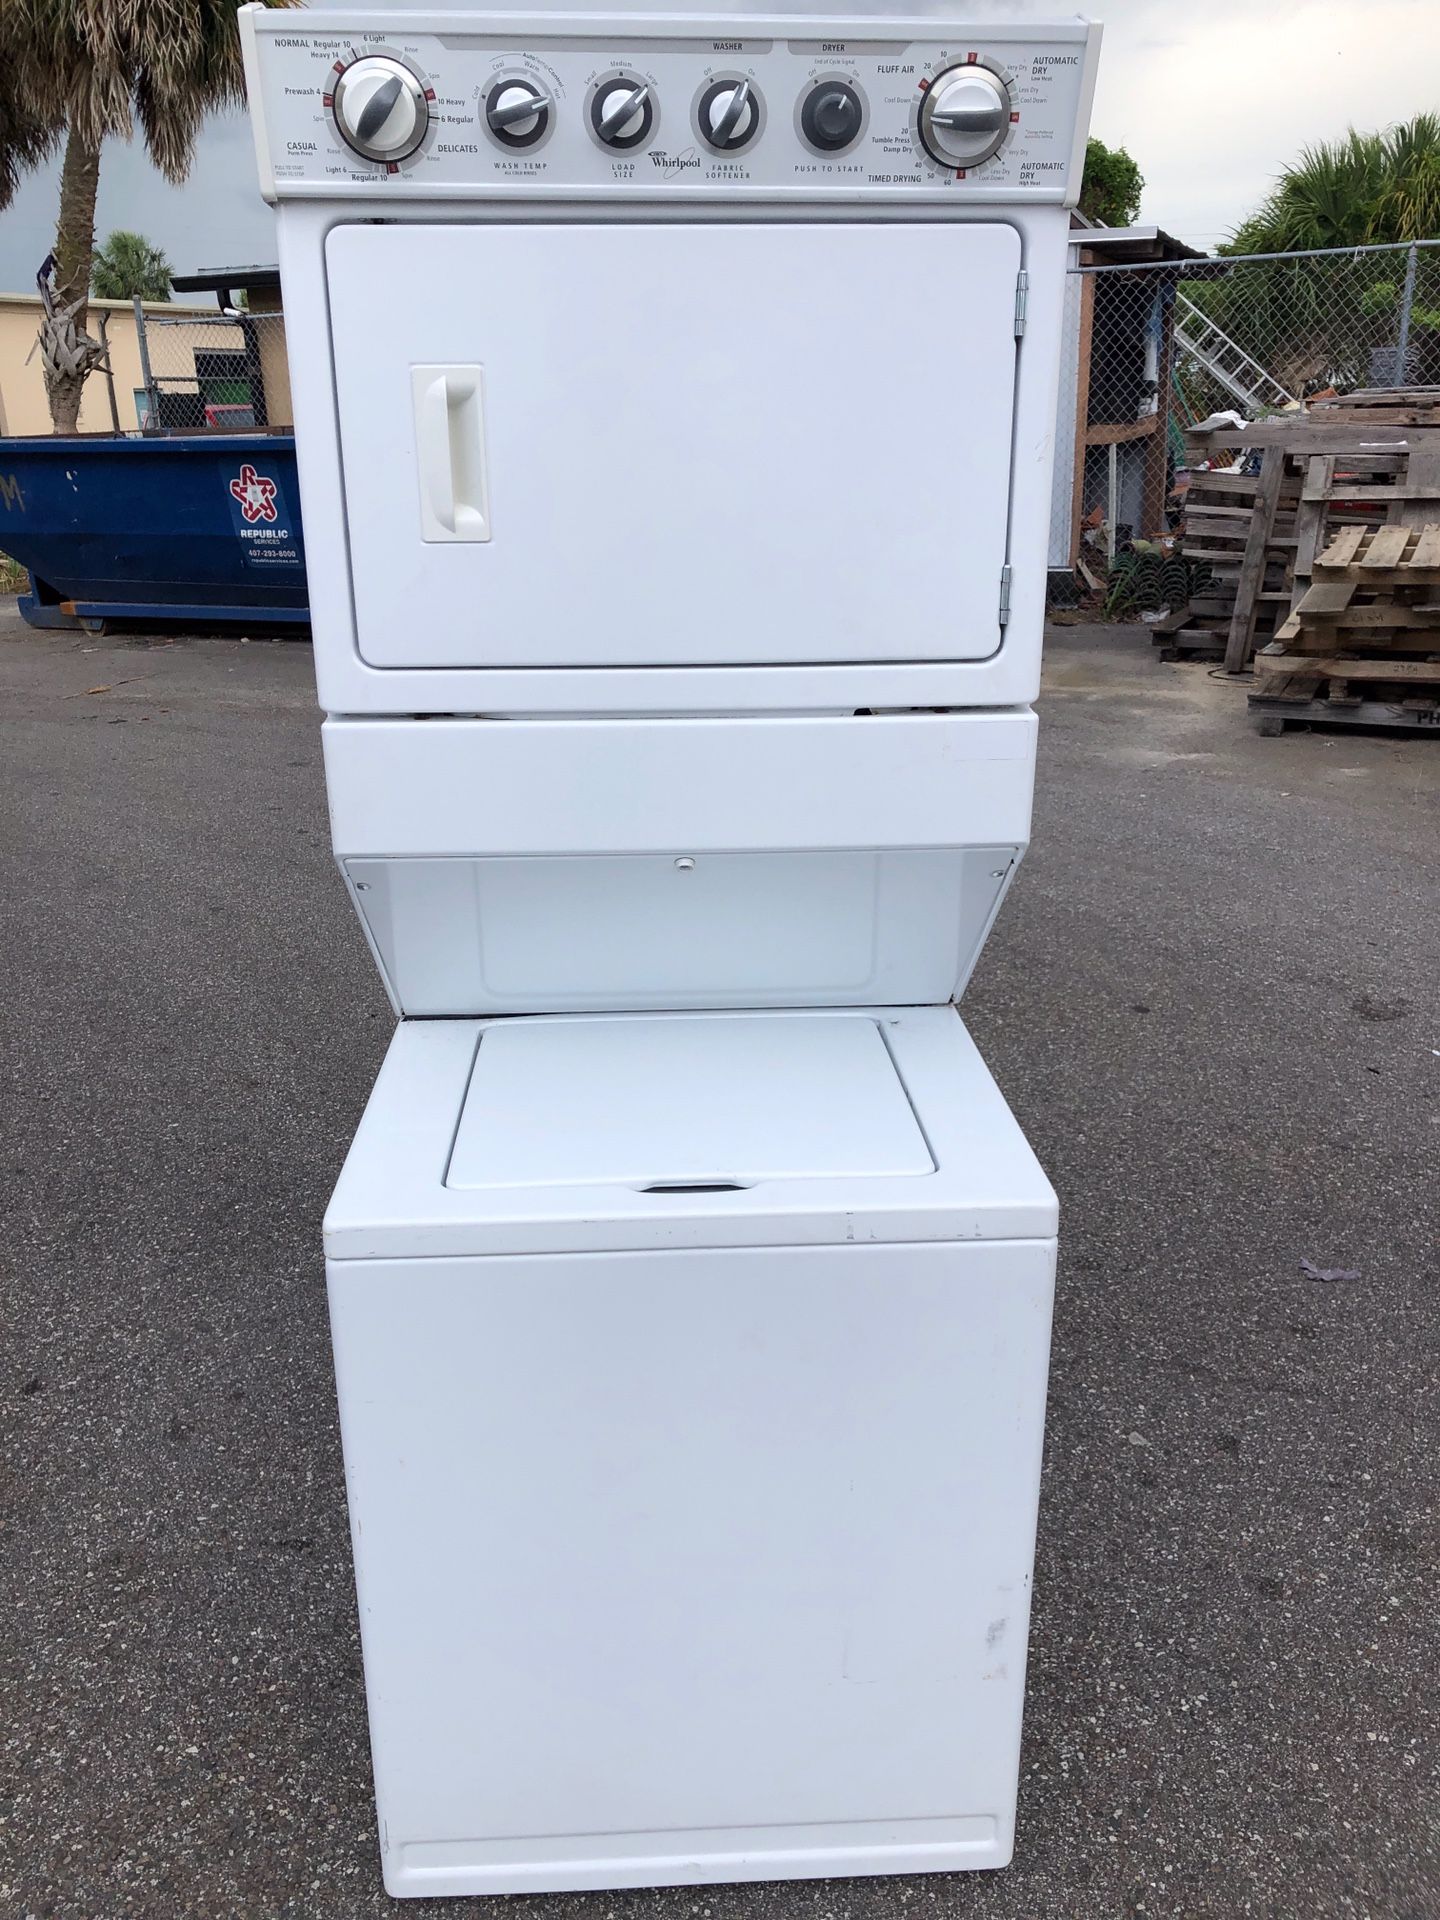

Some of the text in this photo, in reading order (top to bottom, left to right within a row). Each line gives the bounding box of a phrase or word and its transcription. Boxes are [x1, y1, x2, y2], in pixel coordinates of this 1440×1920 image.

[369, 35, 385, 43] Light
[274, 39, 310, 48] NORMAL
[313, 40, 340, 49] Regular
[310, 51, 330, 59] Heavy
[877, 65, 899, 73] FLUFF
[447, 116, 474, 124] Regular
[287, 142, 317, 150] CASUAL
[884, 146, 900, 154] Damp
[652, 157, 700, 170] Whirlpool
[1021, 162, 1064, 170] AUTOMATIC
[326, 166, 341, 174] Light
[352, 174, 378, 182] Regular
[240, 530, 288, 538] REPUBLIC
